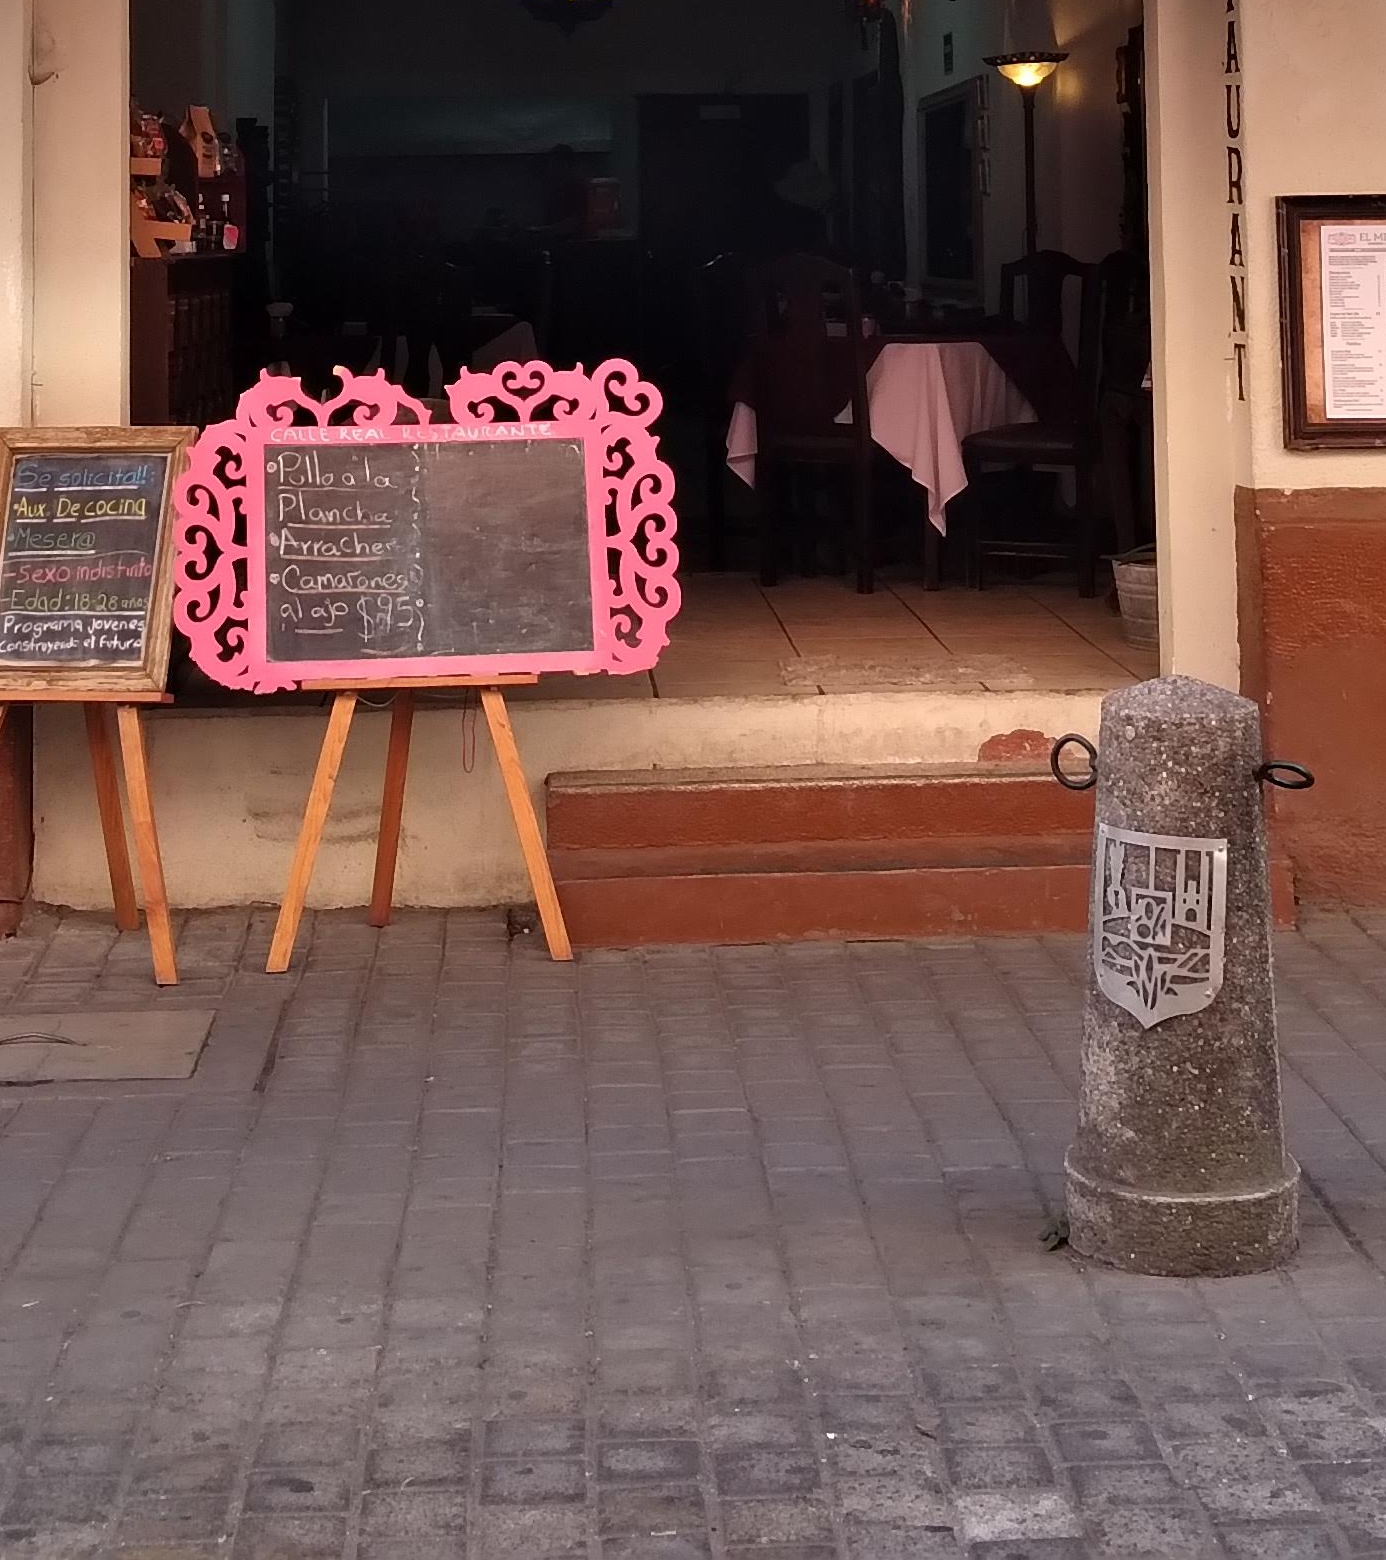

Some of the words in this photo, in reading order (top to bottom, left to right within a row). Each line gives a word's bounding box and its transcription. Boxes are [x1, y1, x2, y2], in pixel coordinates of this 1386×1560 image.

[1359, 232, 1372, 242] EL
[270, 427, 329, 442] CALLE
[339, 427, 387, 440] REAL
[402, 422, 552, 440] RESTAURANTE
[18, 463, 52, 487] Se
[56, 497, 81, 517] De
[278, 490, 393, 523] Plancha
[76, 556, 152, 580] indistinto
[281, 564, 410, 592] Camarones
[3, 615, 83, 638] Programa
[279, 596, 303, 622] al
[310, 597, 349, 627] ajo
[356, 593, 414, 643] $95
[83, 635, 96, 649] el
